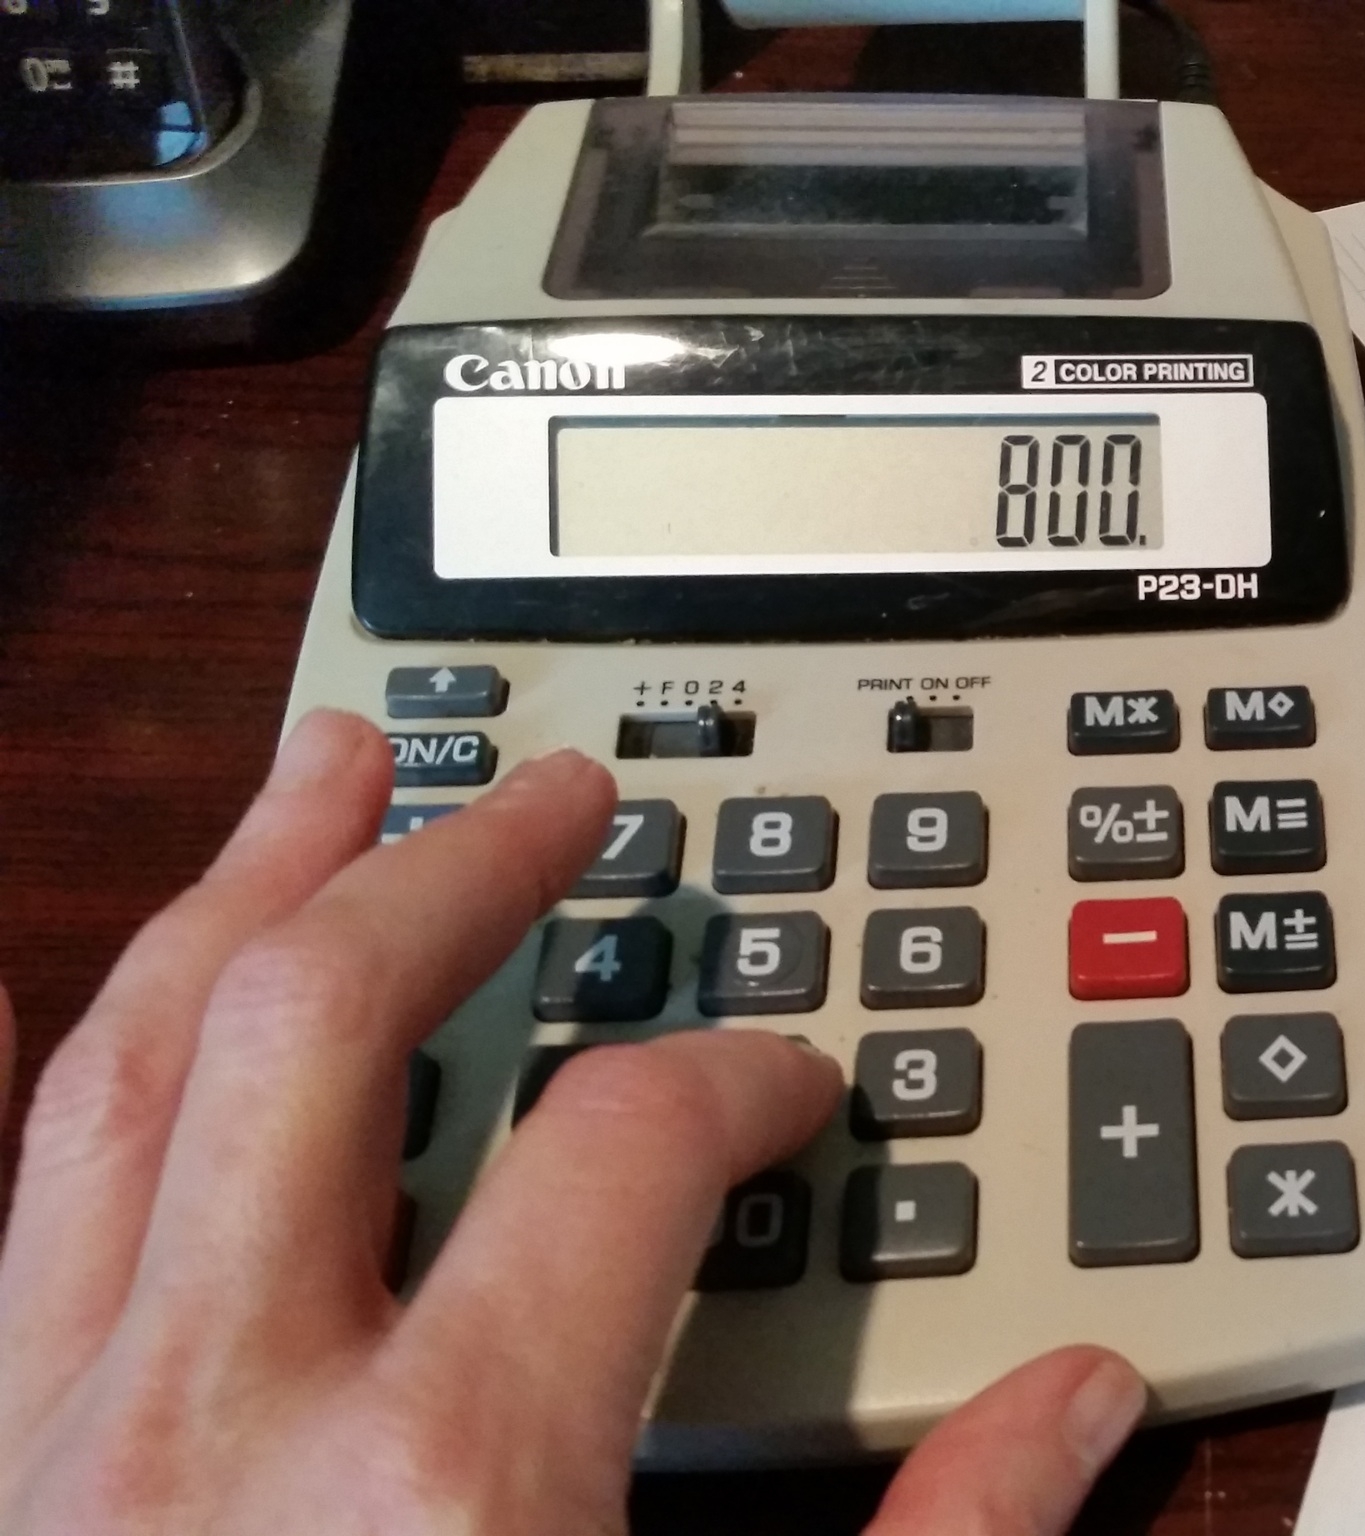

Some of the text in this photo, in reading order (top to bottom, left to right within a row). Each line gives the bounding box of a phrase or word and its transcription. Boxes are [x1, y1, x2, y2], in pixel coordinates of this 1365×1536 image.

[444, 354, 626, 392] Canon
[1031, 361, 1245, 383] 2 COLOR PRINTING
[1138, 573, 1259, 601] P23-DH
[857, 676, 992, 692] PRINT ON OFF
[602, 814, 645, 860] 7
[749, 811, 793, 857] 8
[906, 807, 948, 853] 9
[574, 934, 622, 982] 4
[736, 927, 781, 976] 5
[899, 926, 943, 974] 6
[892, 1049, 937, 1100] 3
